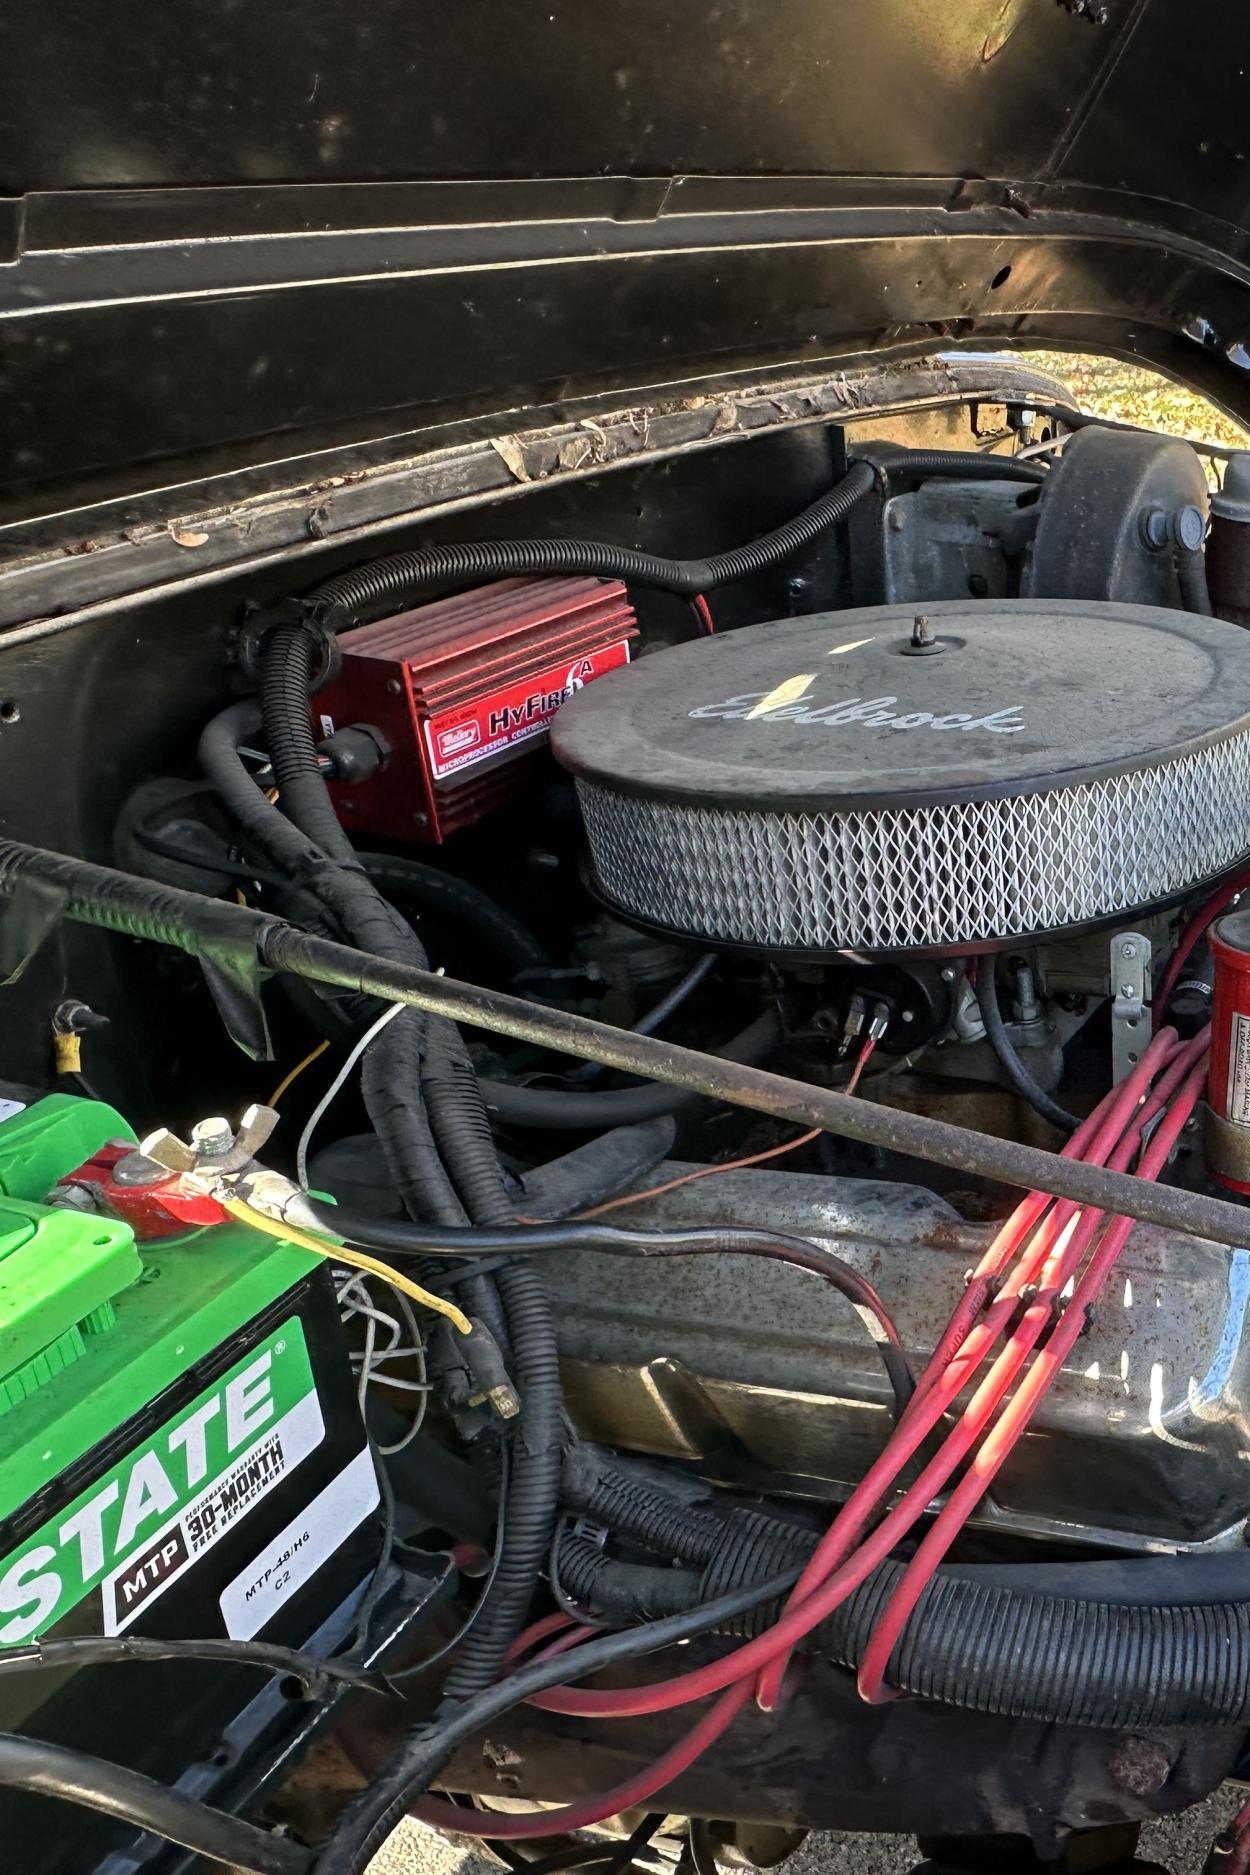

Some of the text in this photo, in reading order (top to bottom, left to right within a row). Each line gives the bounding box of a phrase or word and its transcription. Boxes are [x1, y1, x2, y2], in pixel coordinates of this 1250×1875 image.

[264, 1432, 280, 1450] WITH
[187, 1439, 284, 1543] 30-MONTH
[192, 1459, 286, 1553] FREE REPLACEMENT
[122, 1539, 179, 1603] MTP
[275, 1570, 292, 1591] C2
